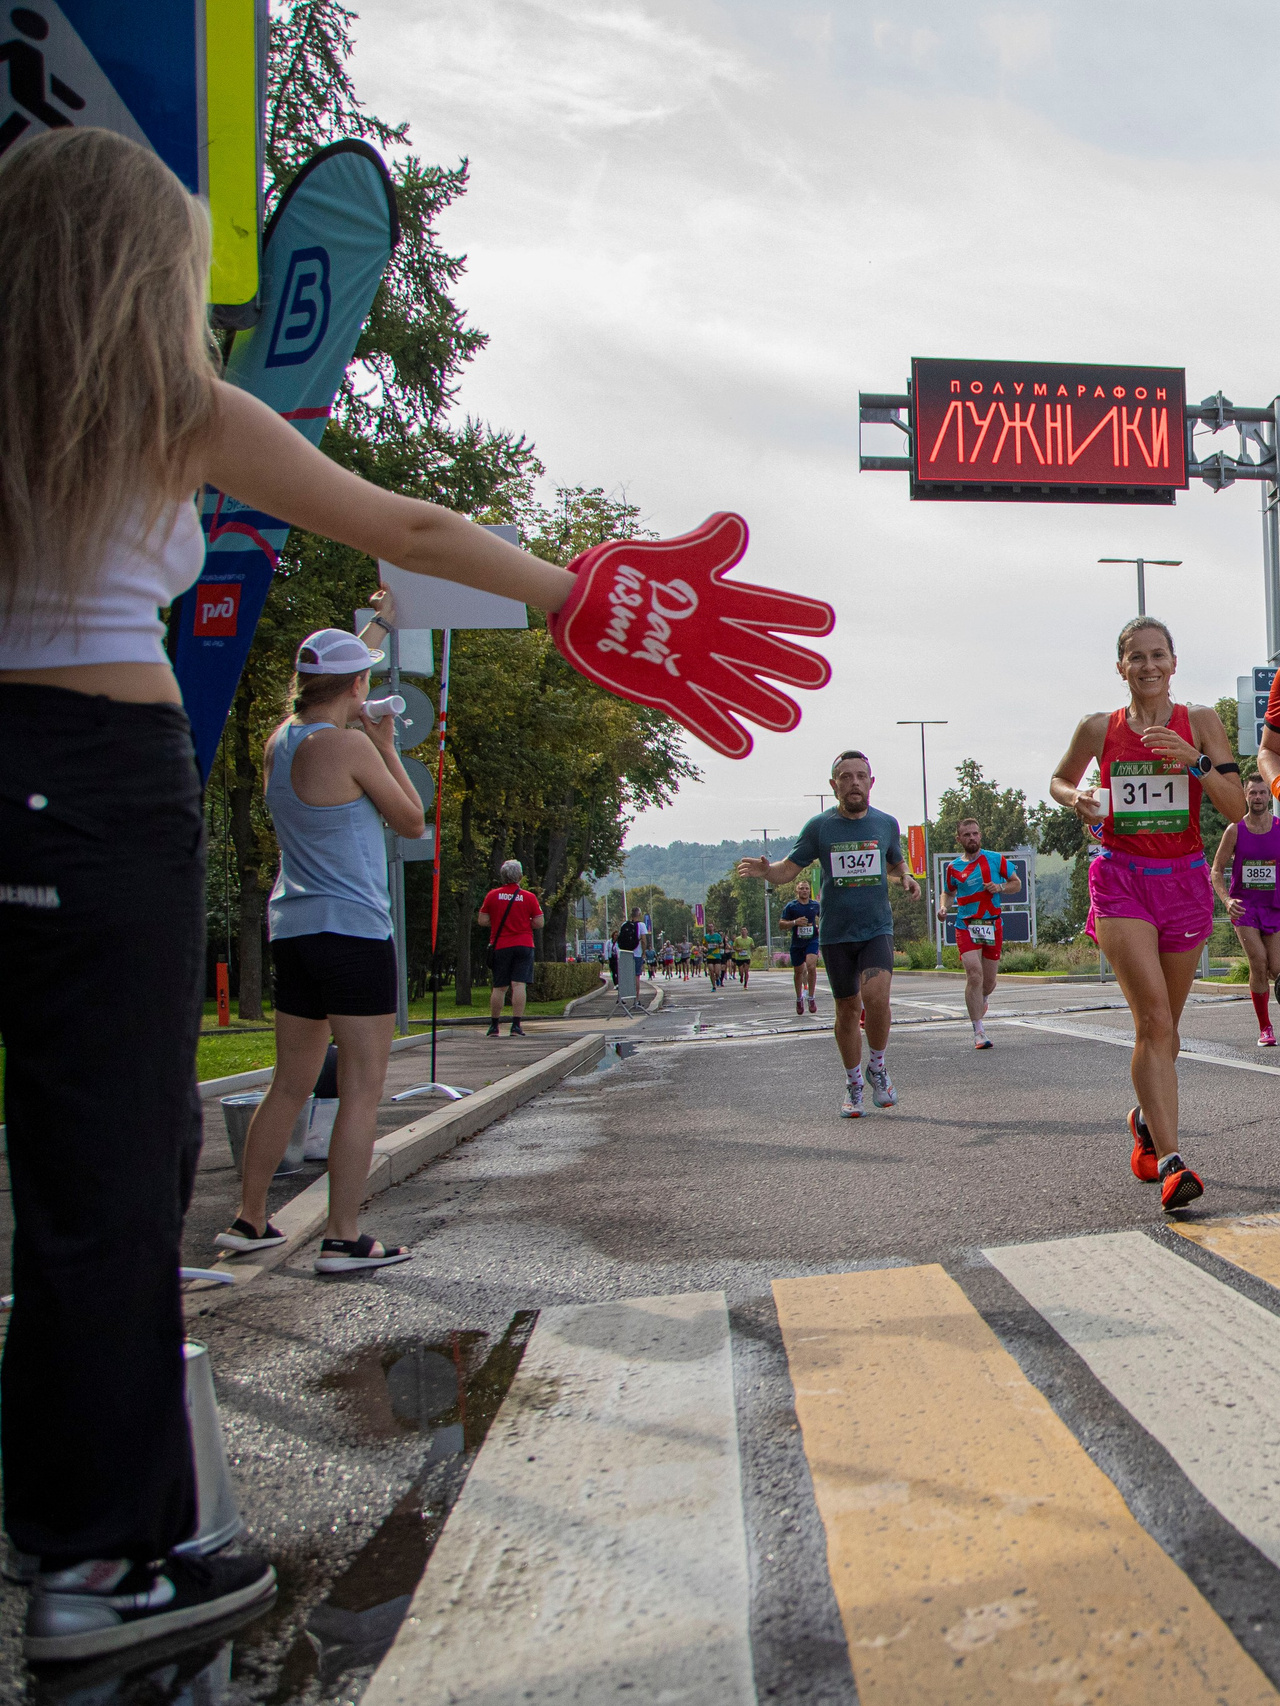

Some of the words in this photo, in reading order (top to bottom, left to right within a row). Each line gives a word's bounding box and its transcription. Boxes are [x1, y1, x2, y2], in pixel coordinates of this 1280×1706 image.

[950, 380, 1167, 400] ПОЛУМАРАФОН
[929, 401, 1169, 468] ЛУЖНИКИ
[597, 564, 646, 655] пять
[631, 578, 699, 677] Дай
[1122, 781, 1174, 805] 31-1
[838, 853, 875, 869] 1347
[1246, 868, 1272, 878] 3852
[498, 893, 524, 902] МОСВА
